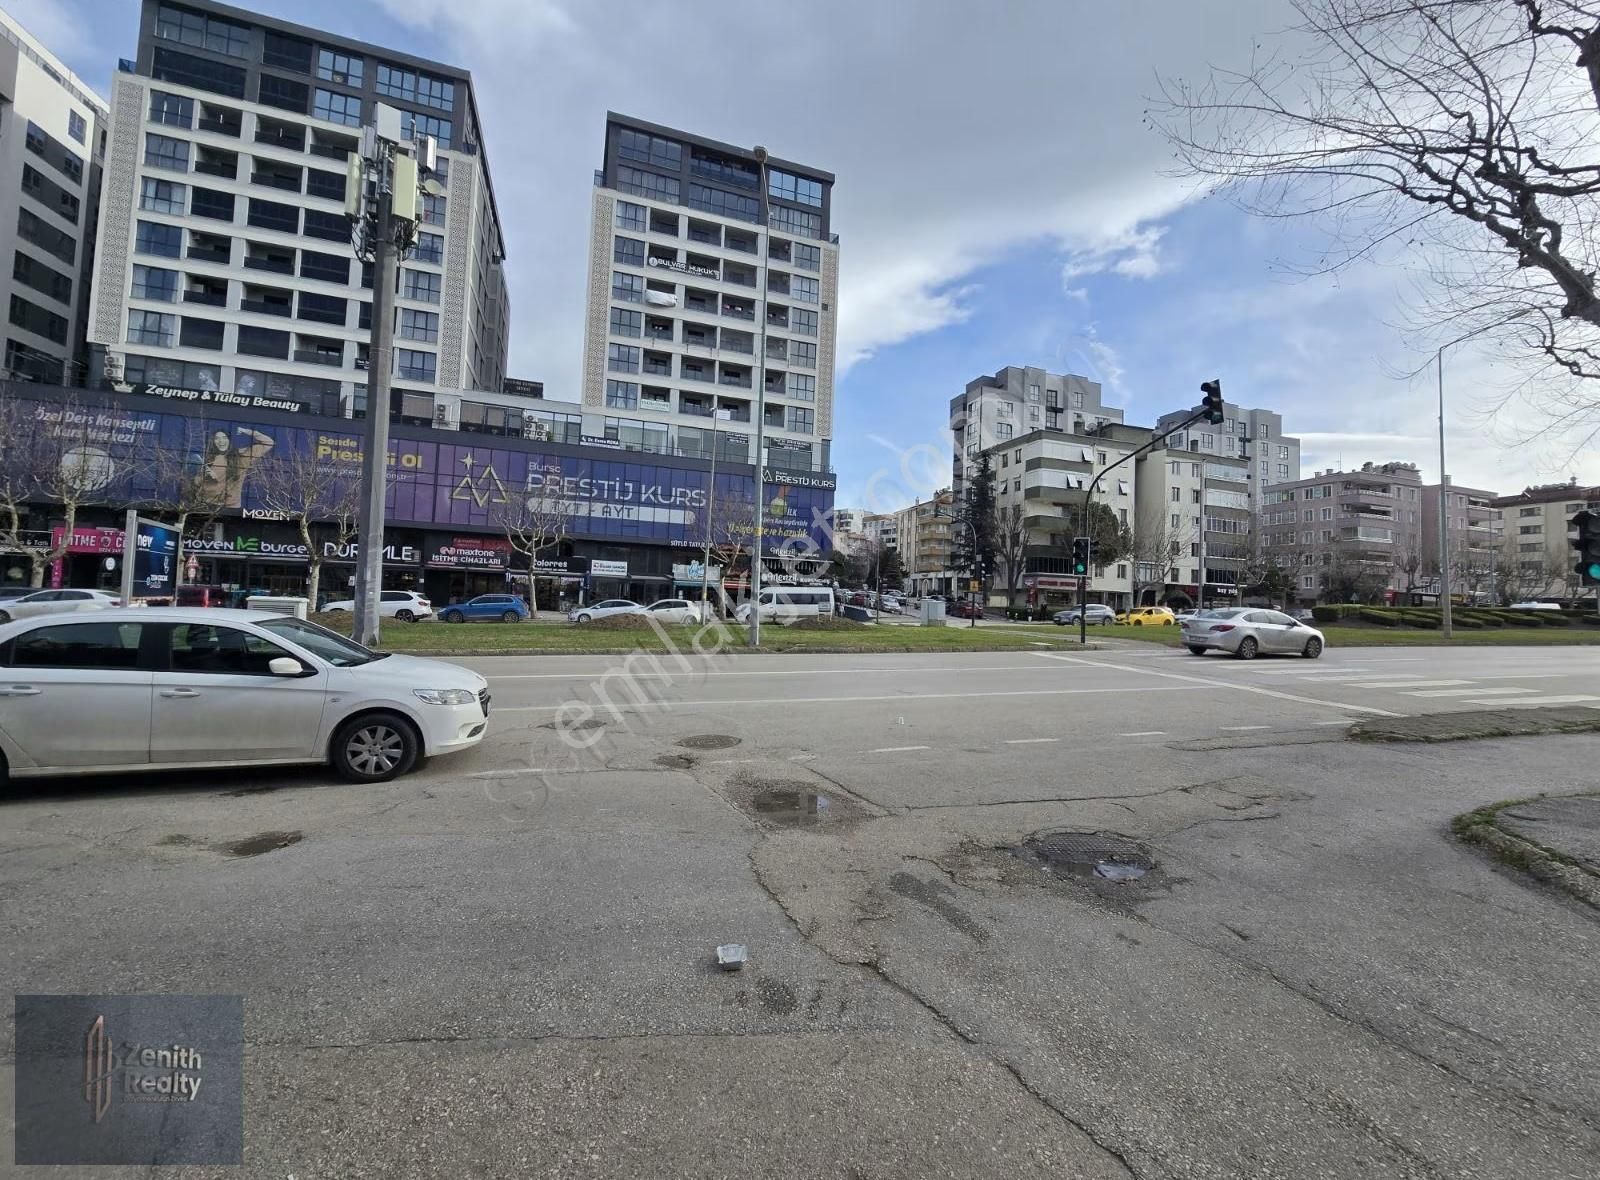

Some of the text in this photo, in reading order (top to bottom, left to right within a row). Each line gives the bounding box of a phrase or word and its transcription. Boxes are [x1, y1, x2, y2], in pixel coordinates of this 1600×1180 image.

[657, 259, 686, 269] BULVAR
[689, 265, 714, 275] HUKUK
[145, 384, 300, 412] Zeynep & Tülay Beauty
[65, 411, 94, 424] Ders
[320, 436, 357, 447] Sende
[812, 479, 835, 488] KURS
[527, 474, 706, 507] PRESTİJ KURS
[243, 508, 290, 521] MOVEN
[602, 505, 634, 518] AYT
[456, 548, 494, 557] maxtone
